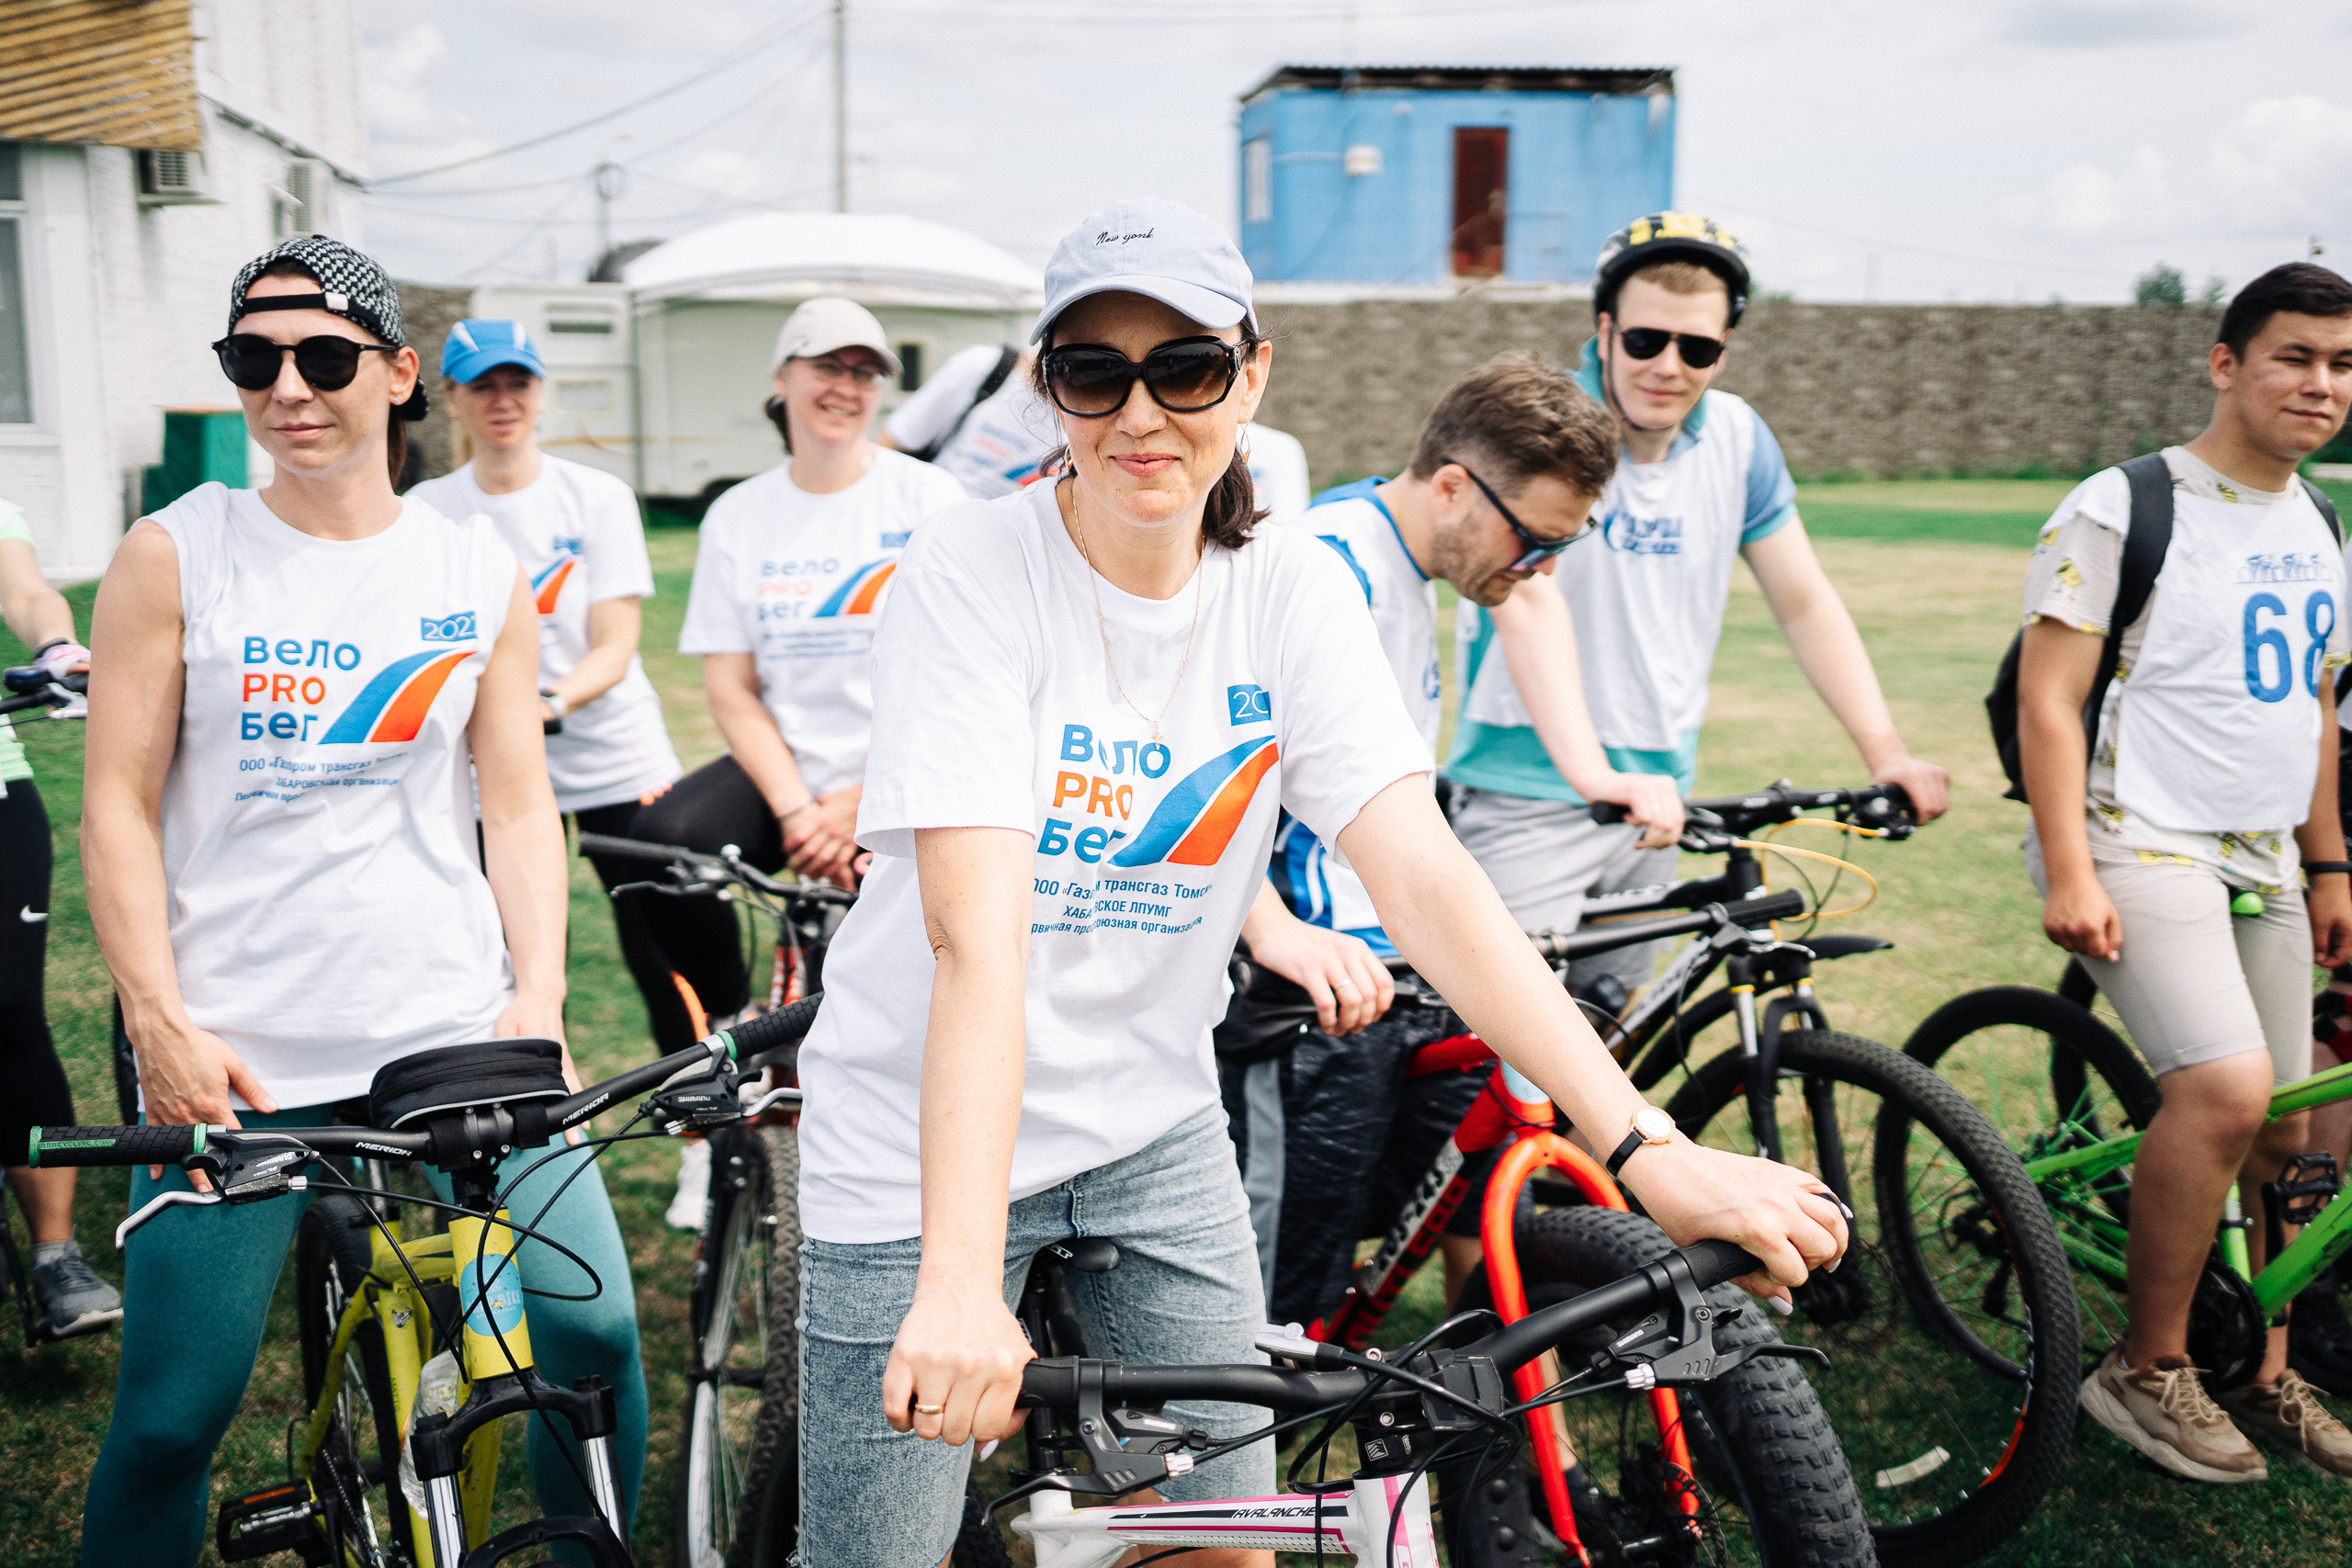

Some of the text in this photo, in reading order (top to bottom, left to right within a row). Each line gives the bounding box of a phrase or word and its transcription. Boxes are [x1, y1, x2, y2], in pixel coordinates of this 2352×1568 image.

[2243, 589, 2335, 704] 68
[243, 673, 325, 705] PRO
[1233, 690, 1270, 718] 20
[1053, 771, 1133, 820] PRO
[1104, 879, 1169, 896] трансгаз
[1129, 902, 1172, 918] ЛПУМГ
[562, 1092, 609, 1125] MERIDA
[1233, 1506, 1317, 1518] AVALANCHE
